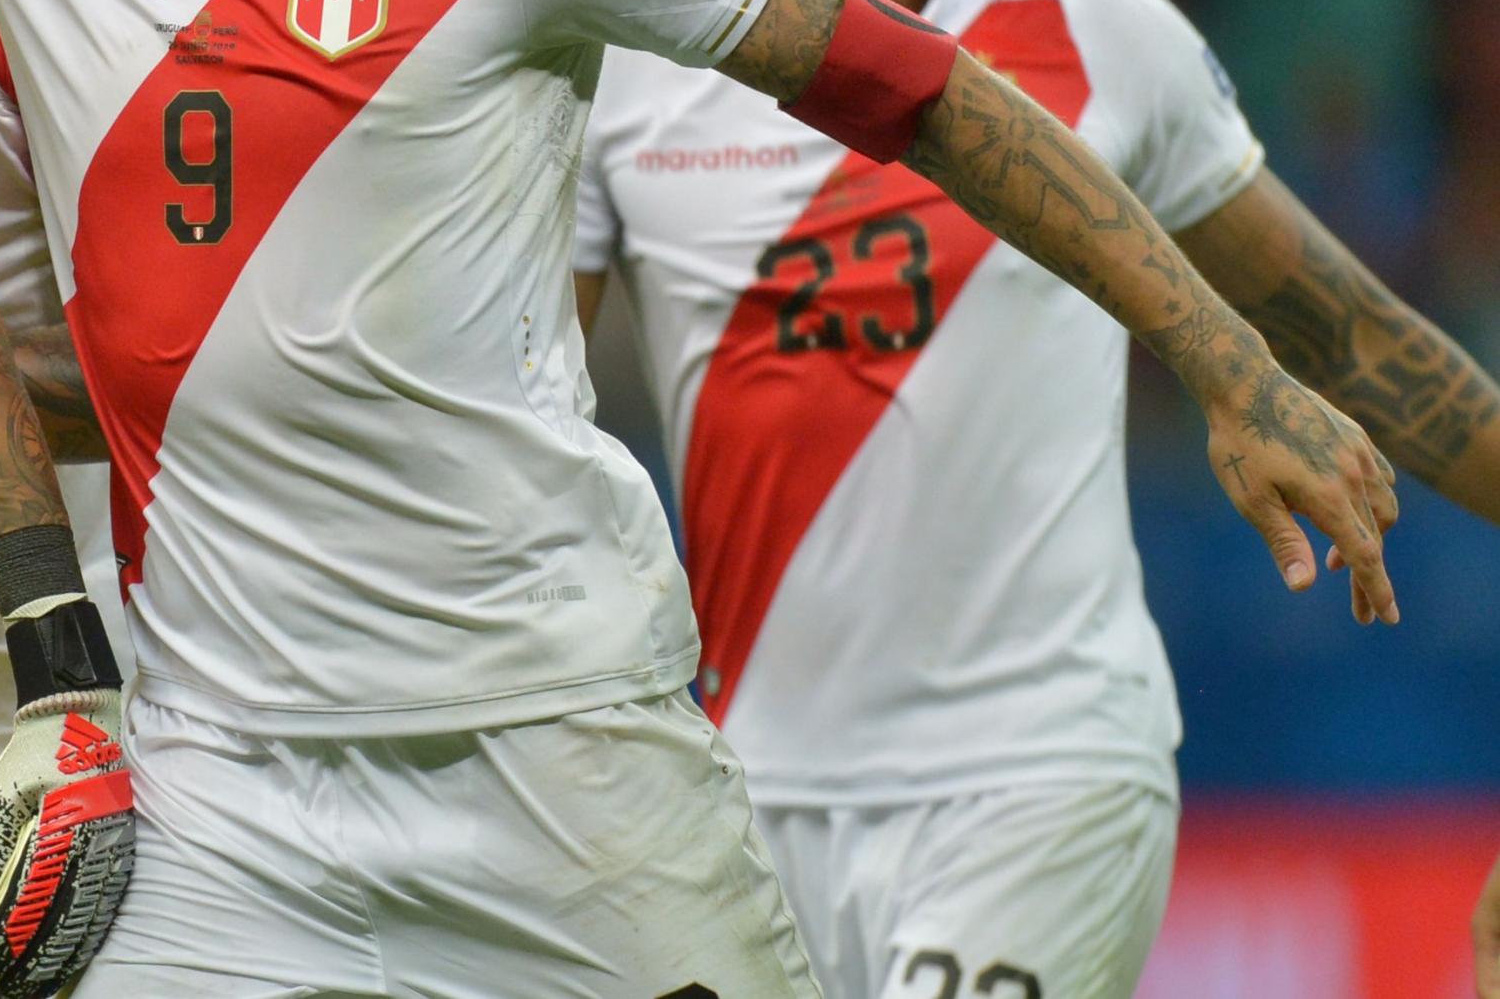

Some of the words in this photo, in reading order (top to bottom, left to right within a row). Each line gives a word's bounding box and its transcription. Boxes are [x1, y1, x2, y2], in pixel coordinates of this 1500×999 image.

[163, 90, 233, 246] 9
[635, 143, 799, 172] marathon
[756, 212, 935, 354] 23
[58, 743, 123, 775] adidas
